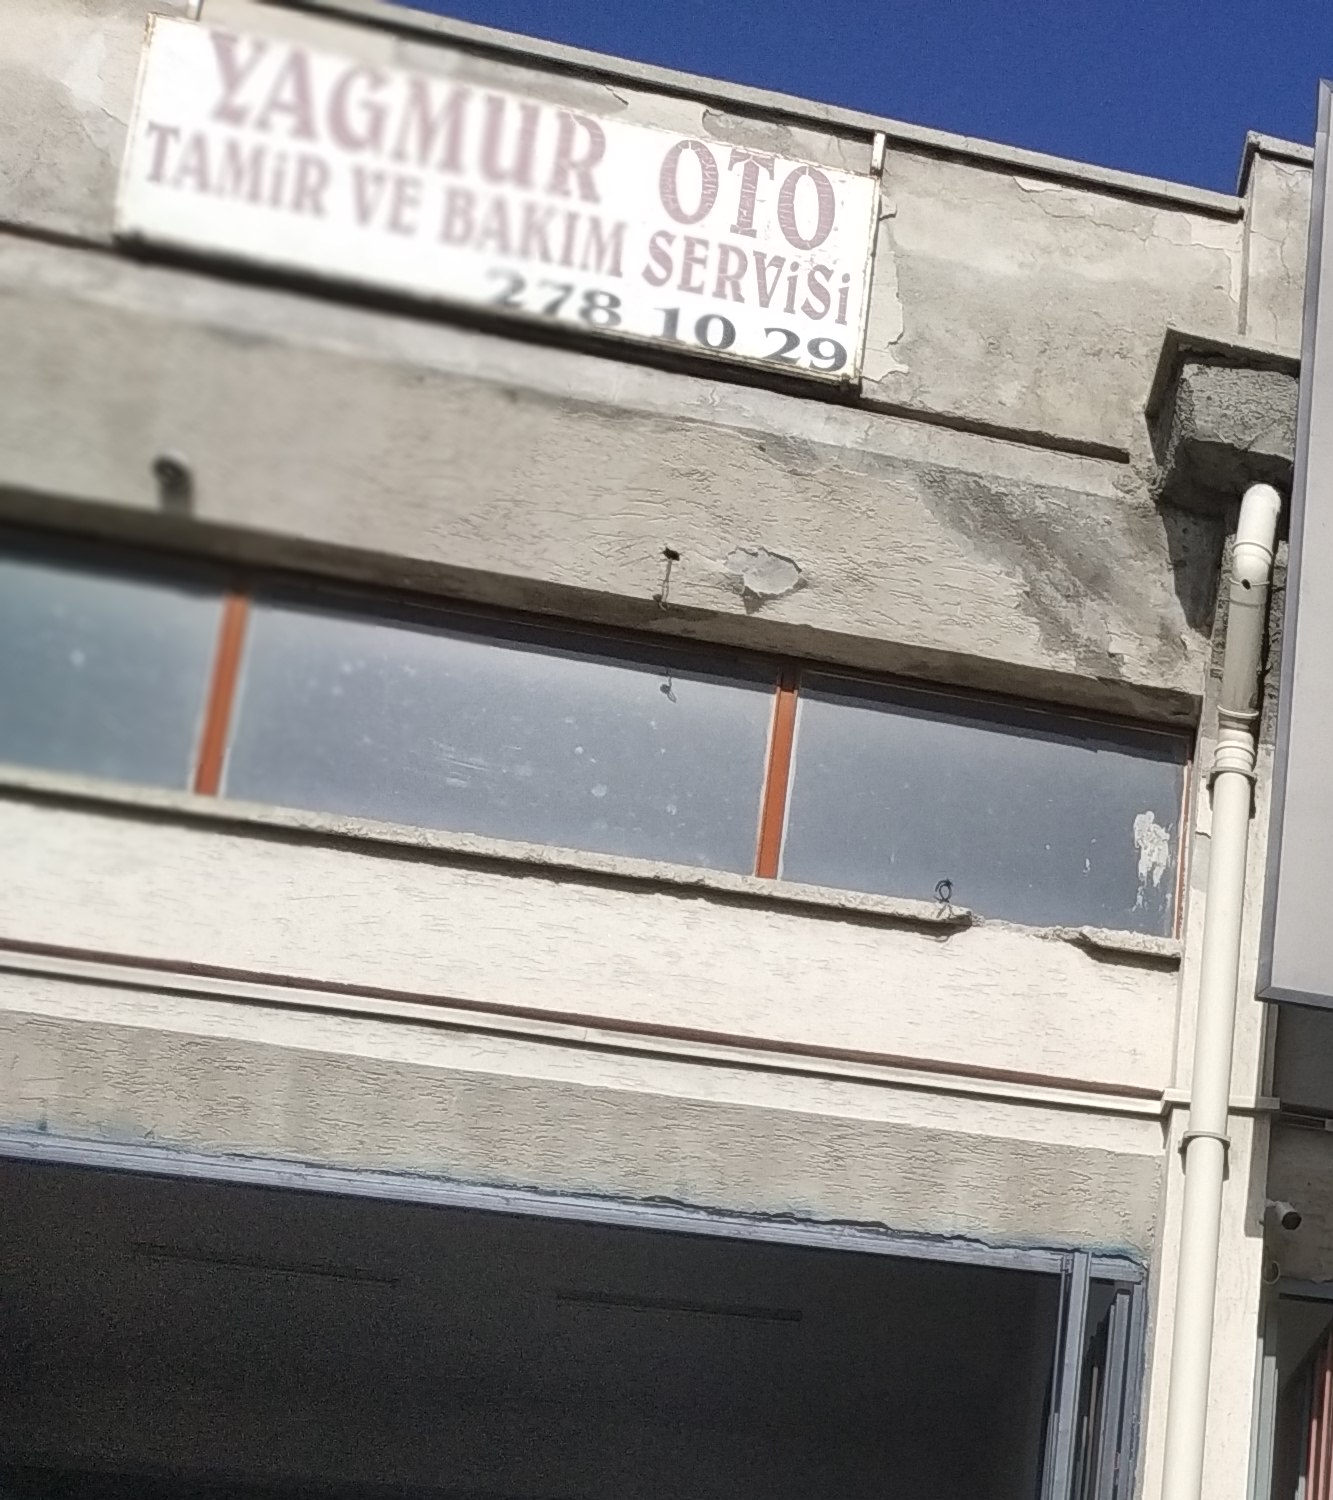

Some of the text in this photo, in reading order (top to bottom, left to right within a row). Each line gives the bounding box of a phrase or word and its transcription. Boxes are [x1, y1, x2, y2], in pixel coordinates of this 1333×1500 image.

[351, 164, 425, 238] VE
[439, 187, 627, 278] BAKIM
[659, 138, 836, 251] OTO
[486, 266, 849, 373] 278 10 29
